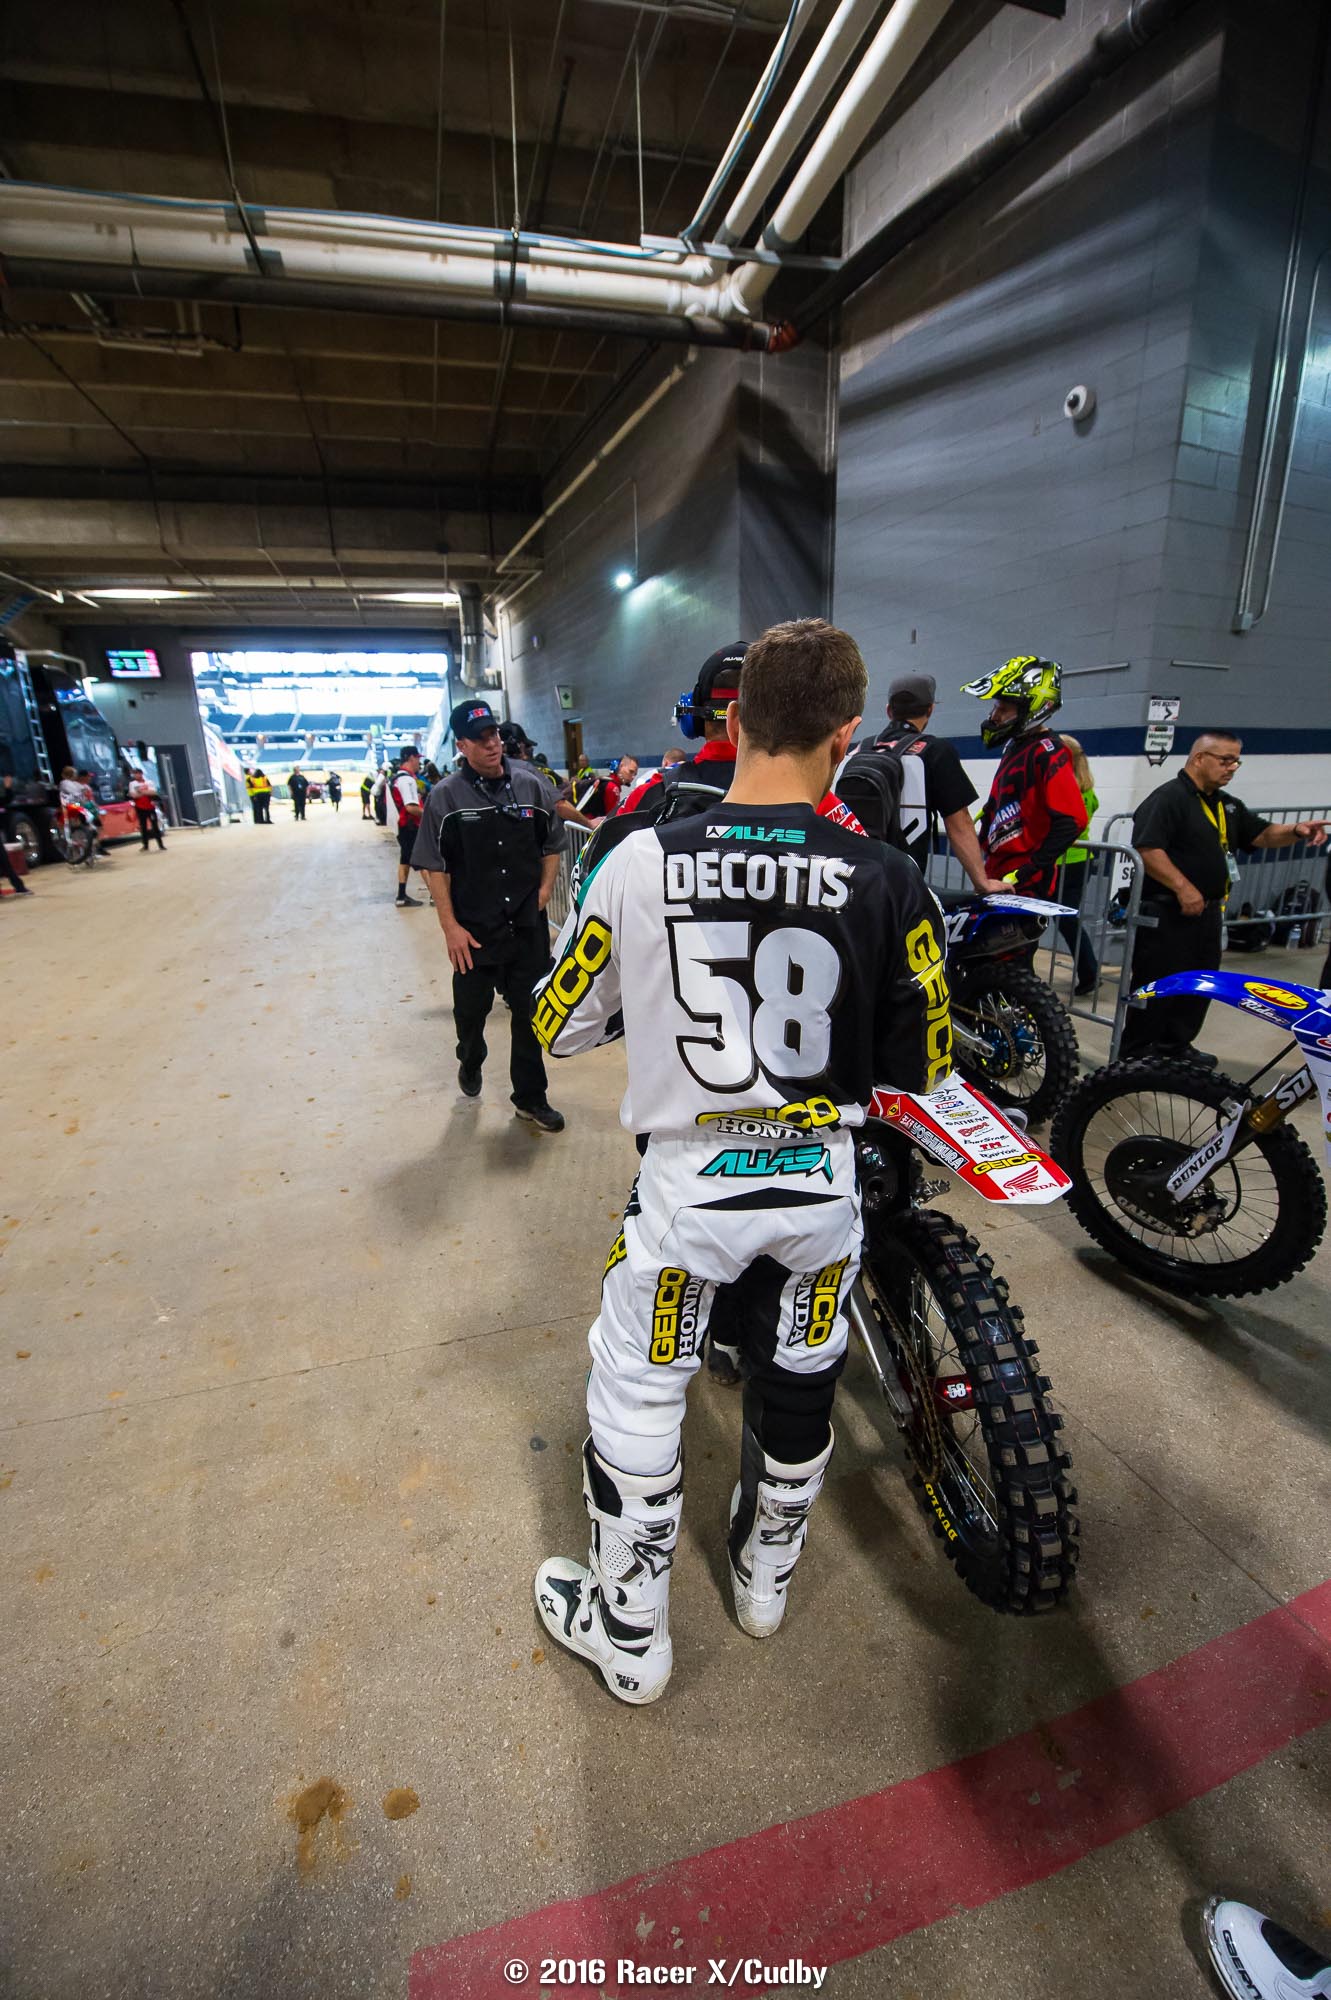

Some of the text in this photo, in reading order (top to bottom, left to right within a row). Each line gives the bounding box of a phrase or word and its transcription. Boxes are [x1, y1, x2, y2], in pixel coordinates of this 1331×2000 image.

[723, 825, 806, 844] ALIAS
[666, 850, 855, 909] DECOTIS
[667, 919, 843, 1092] 58
[905, 918, 953, 1094] GEICO
[911, 1121, 967, 1170] YOSHIMURA
[953, 1115, 990, 1126] ATHENA
[698, 1143, 826, 1177] ALIAS
[972, 1152, 1045, 1176] GEICO
[1171, 1135, 1225, 1192] DUNLOP
[1009, 1181, 1059, 1198] HONDA
[651, 1267, 689, 1365] GEICO
[678, 1275, 703, 1356] HONDA
[789, 1271, 820, 1345] ONDA
[946, 1382, 967, 1399] 58
[924, 1482, 958, 1541] DUNLO
[1222, 1929, 1264, 2000] GAERN
